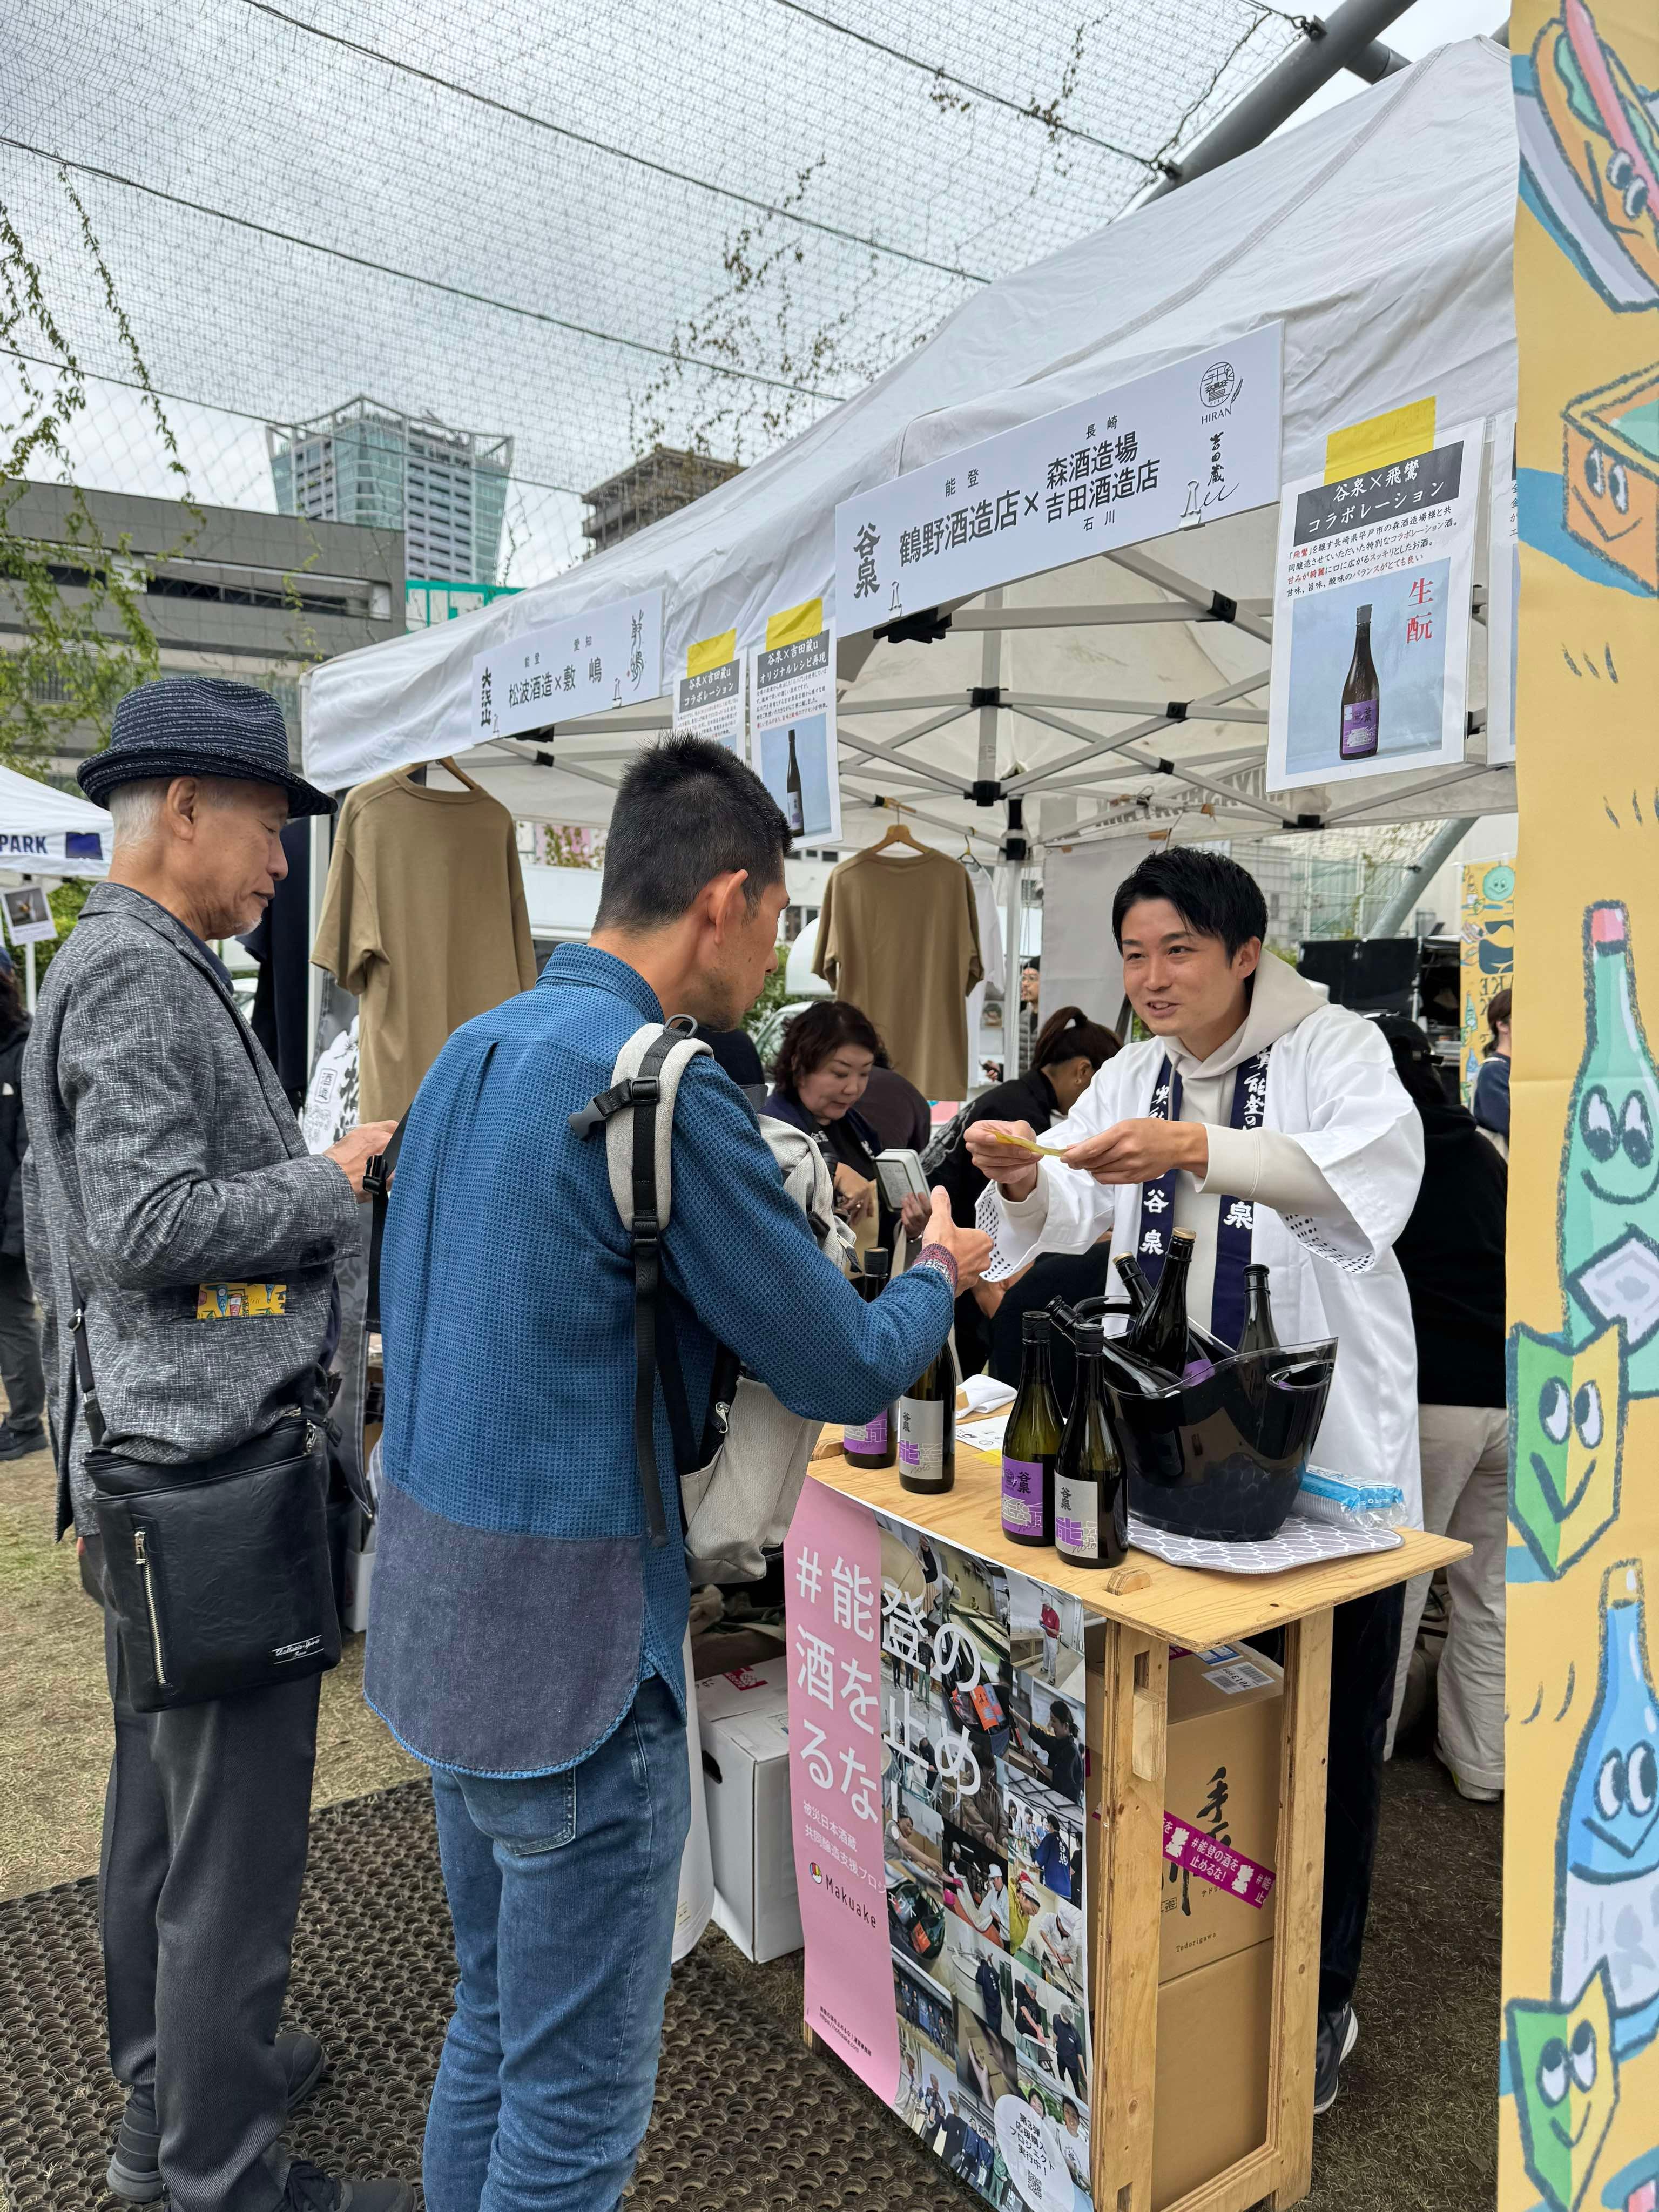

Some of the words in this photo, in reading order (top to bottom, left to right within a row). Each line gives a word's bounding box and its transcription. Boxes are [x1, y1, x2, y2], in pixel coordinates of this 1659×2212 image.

[1085, 415, 1118, 439] 長崎
[1202, 408, 1232, 424] HIRAN
[1047, 431, 1138, 489] 森酒造場
[945, 468, 979, 498] 能登
[1045, 460, 1159, 524] 吉田酒造店
[1083, 509, 1115, 531] 石川
[1308, 481, 1445, 533] コラボレーション
[852, 522, 881, 599] 谷泉
[760, 651, 827, 684] オリジナルレシピ再現
[684, 682, 734, 706] コラボレーション
[0, 834, 48, 854] PARK
[1139, 1189, 1169, 1256] 谷泉
[1224, 1201, 1253, 1230] 泉
[1017, 1471, 1032, 1494] 谷泉
[1060, 1486, 1072, 1512] 谷泉
[795, 1624, 982, 1796] 酒を止め
[1191, 1837, 1239, 1871] #能登の酒を
[825, 1874, 876, 1928] Makuake
[1175, 1932, 1217, 1953] Tedorigawa
[1019, 2112, 1041, 2137] 第3弾
[1009, 2126, 1055, 2170] プロジェクト
